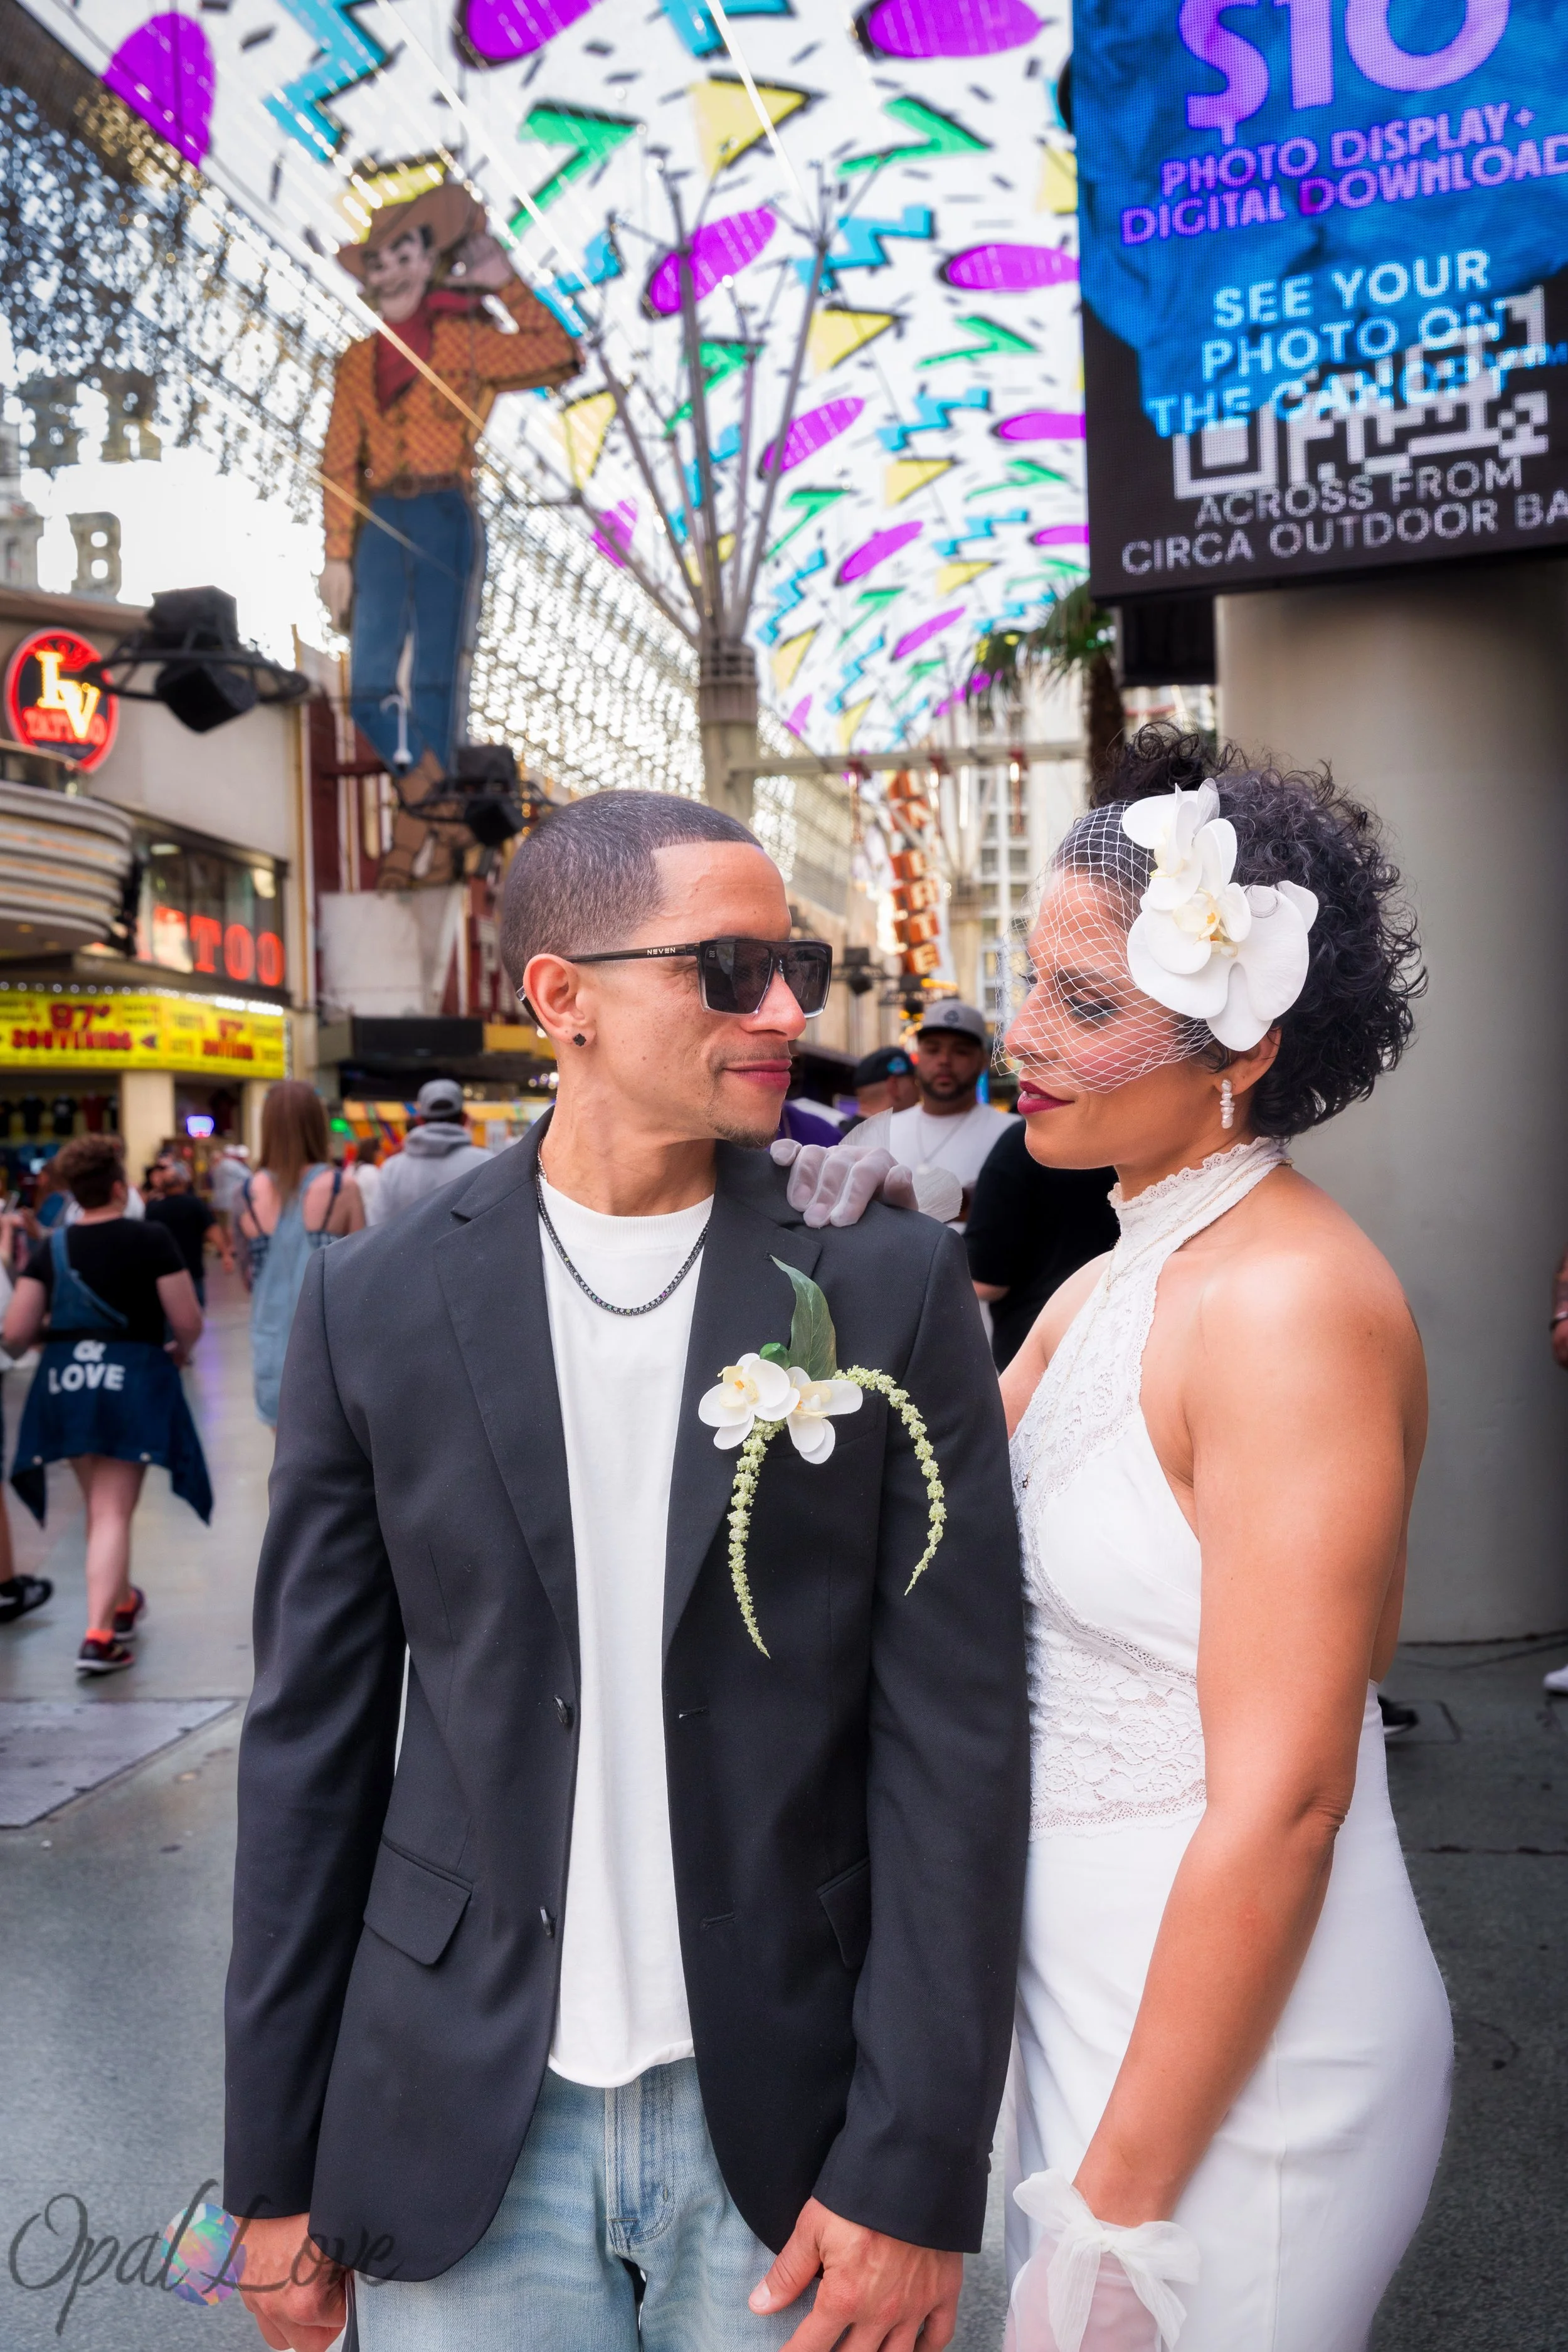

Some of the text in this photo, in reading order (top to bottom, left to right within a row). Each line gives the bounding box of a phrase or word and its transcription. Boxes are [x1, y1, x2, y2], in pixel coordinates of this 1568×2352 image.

[1180, 0, 1510, 144] $10
[1121, 133, 1568, 244] DIGITAL DOWNLOAD
[1162, 137, 1318, 197] PHOTO
[1214, 249, 1490, 329] SEE YOUR
[1202, 298, 1505, 381] PHOTO ON
[1146, 384, 1251, 437] THE
[1195, 458, 1522, 528] ACROSS FROM
[1122, 531, 1254, 575] CIRCA
[1269, 500, 1499, 557] OUTDOOR
[647, 947, 676, 956] NEVEN
[48, 1362, 125, 1394] LOVE
[73, 1339, 107, 1362] &
